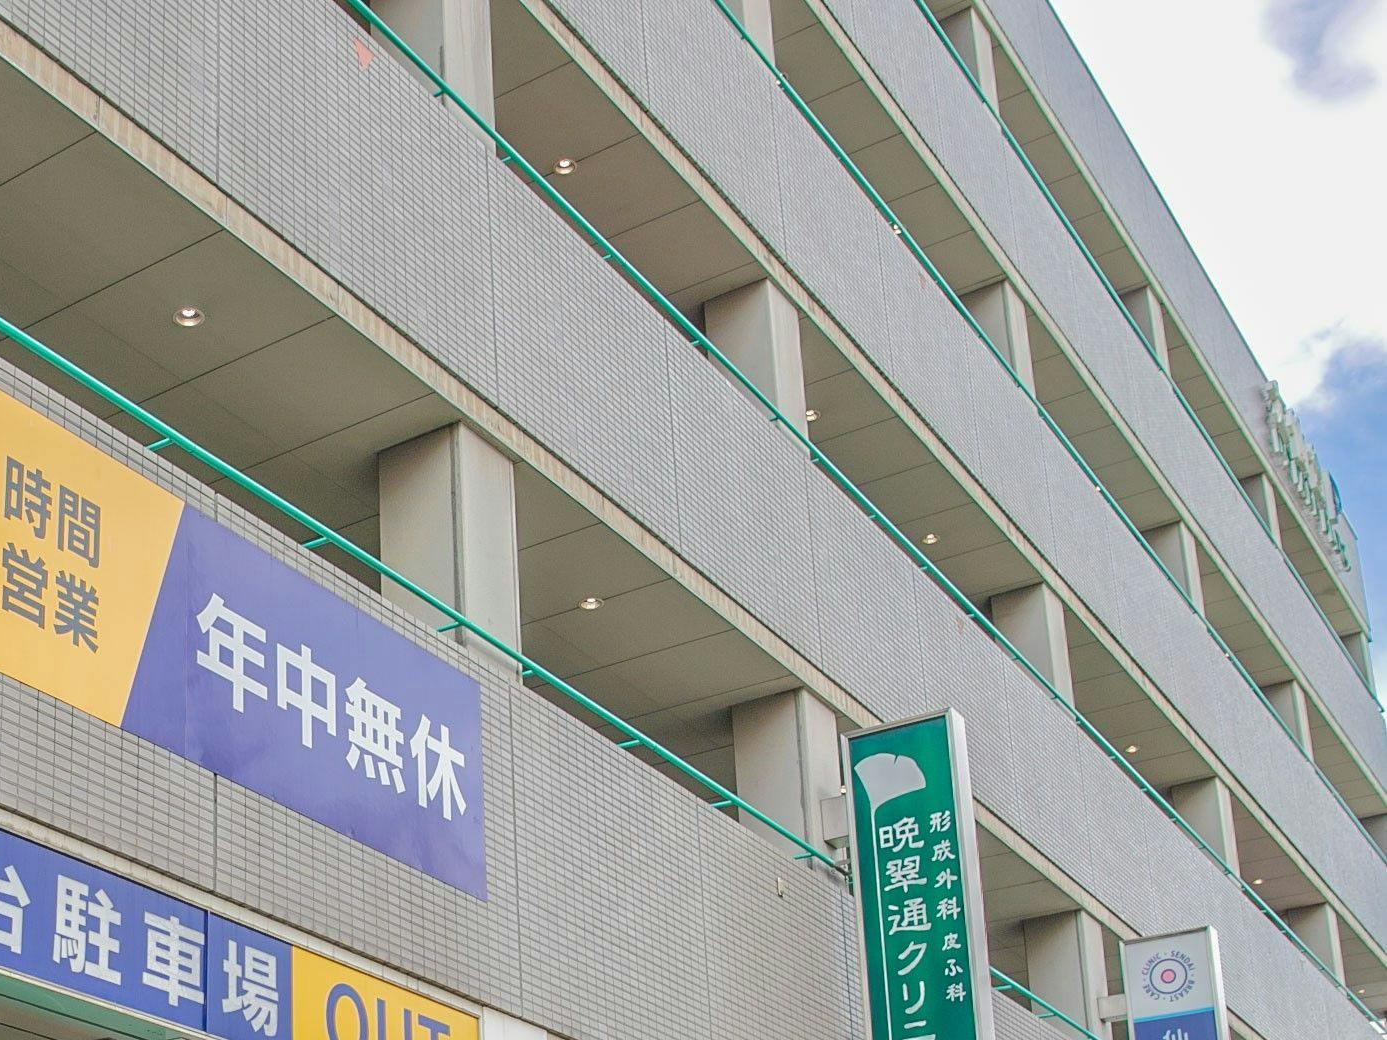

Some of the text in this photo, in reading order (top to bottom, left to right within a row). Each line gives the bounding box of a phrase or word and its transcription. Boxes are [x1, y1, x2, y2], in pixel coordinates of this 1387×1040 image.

[4, 455, 102, 569] 時間
[0, 542, 100, 654] 営業
[194, 593, 467, 821] 年中無休
[1142, 953, 1161, 975] CLINIC
[1171, 950, 1195, 971] SENDAI
